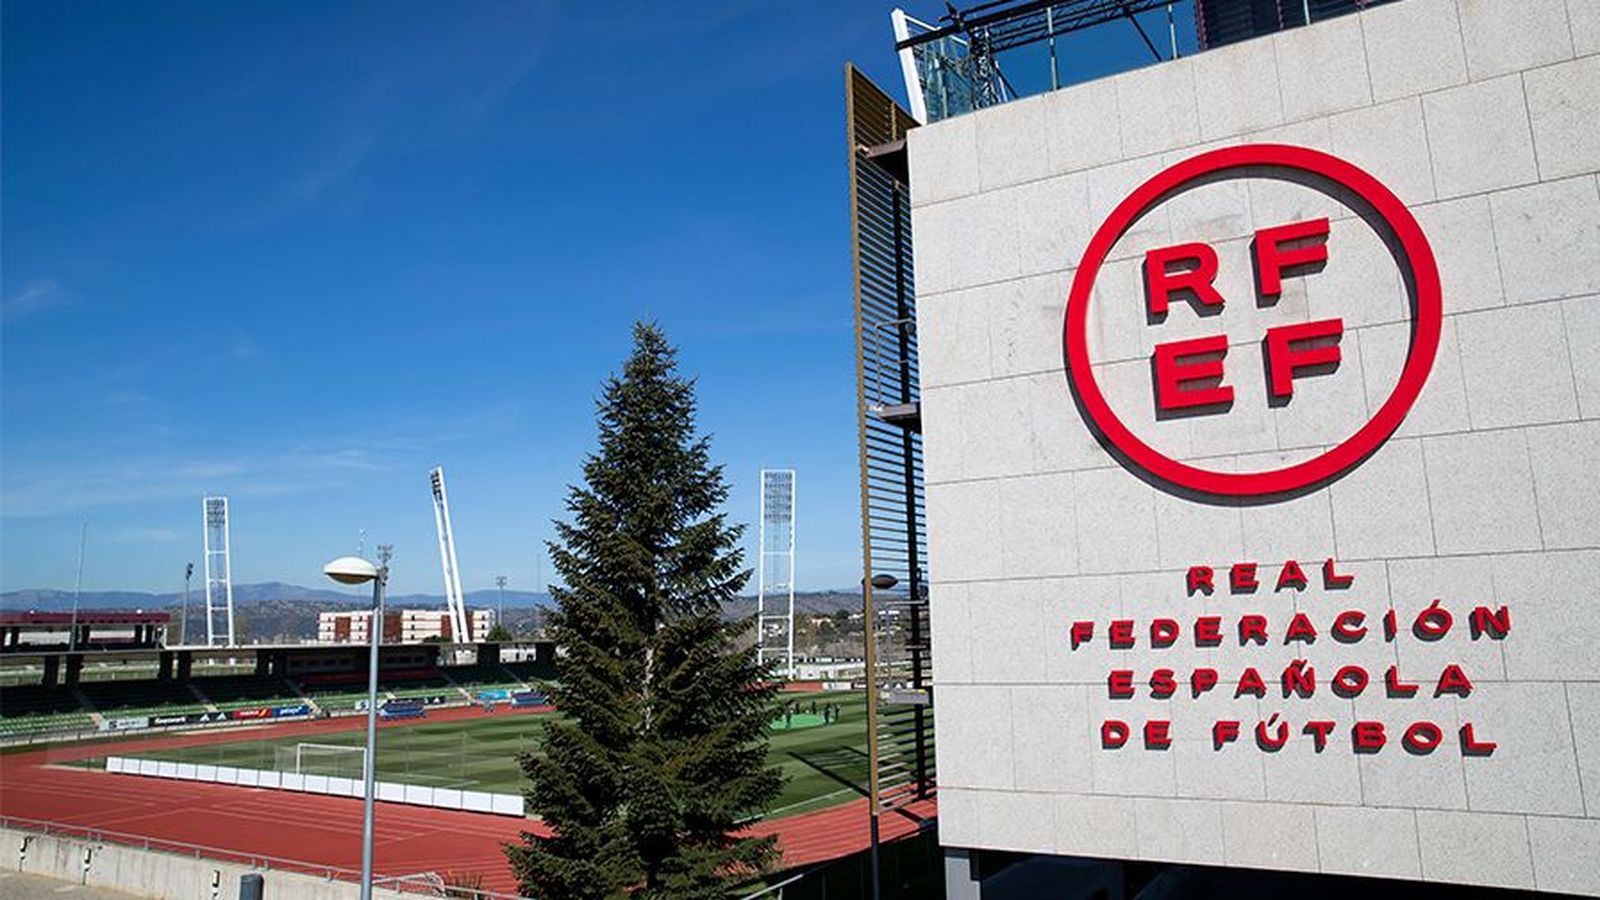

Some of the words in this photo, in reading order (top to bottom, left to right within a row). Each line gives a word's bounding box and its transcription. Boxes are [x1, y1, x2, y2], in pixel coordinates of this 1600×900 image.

[1187, 558, 1354, 591] REAL
[1072, 600, 1511, 645] FEDERACIÓN
[1109, 659, 1474, 695] ESPAÑOLA
[1102, 719, 1172, 746] DE
[1215, 713, 1497, 752] FÚTBOL
